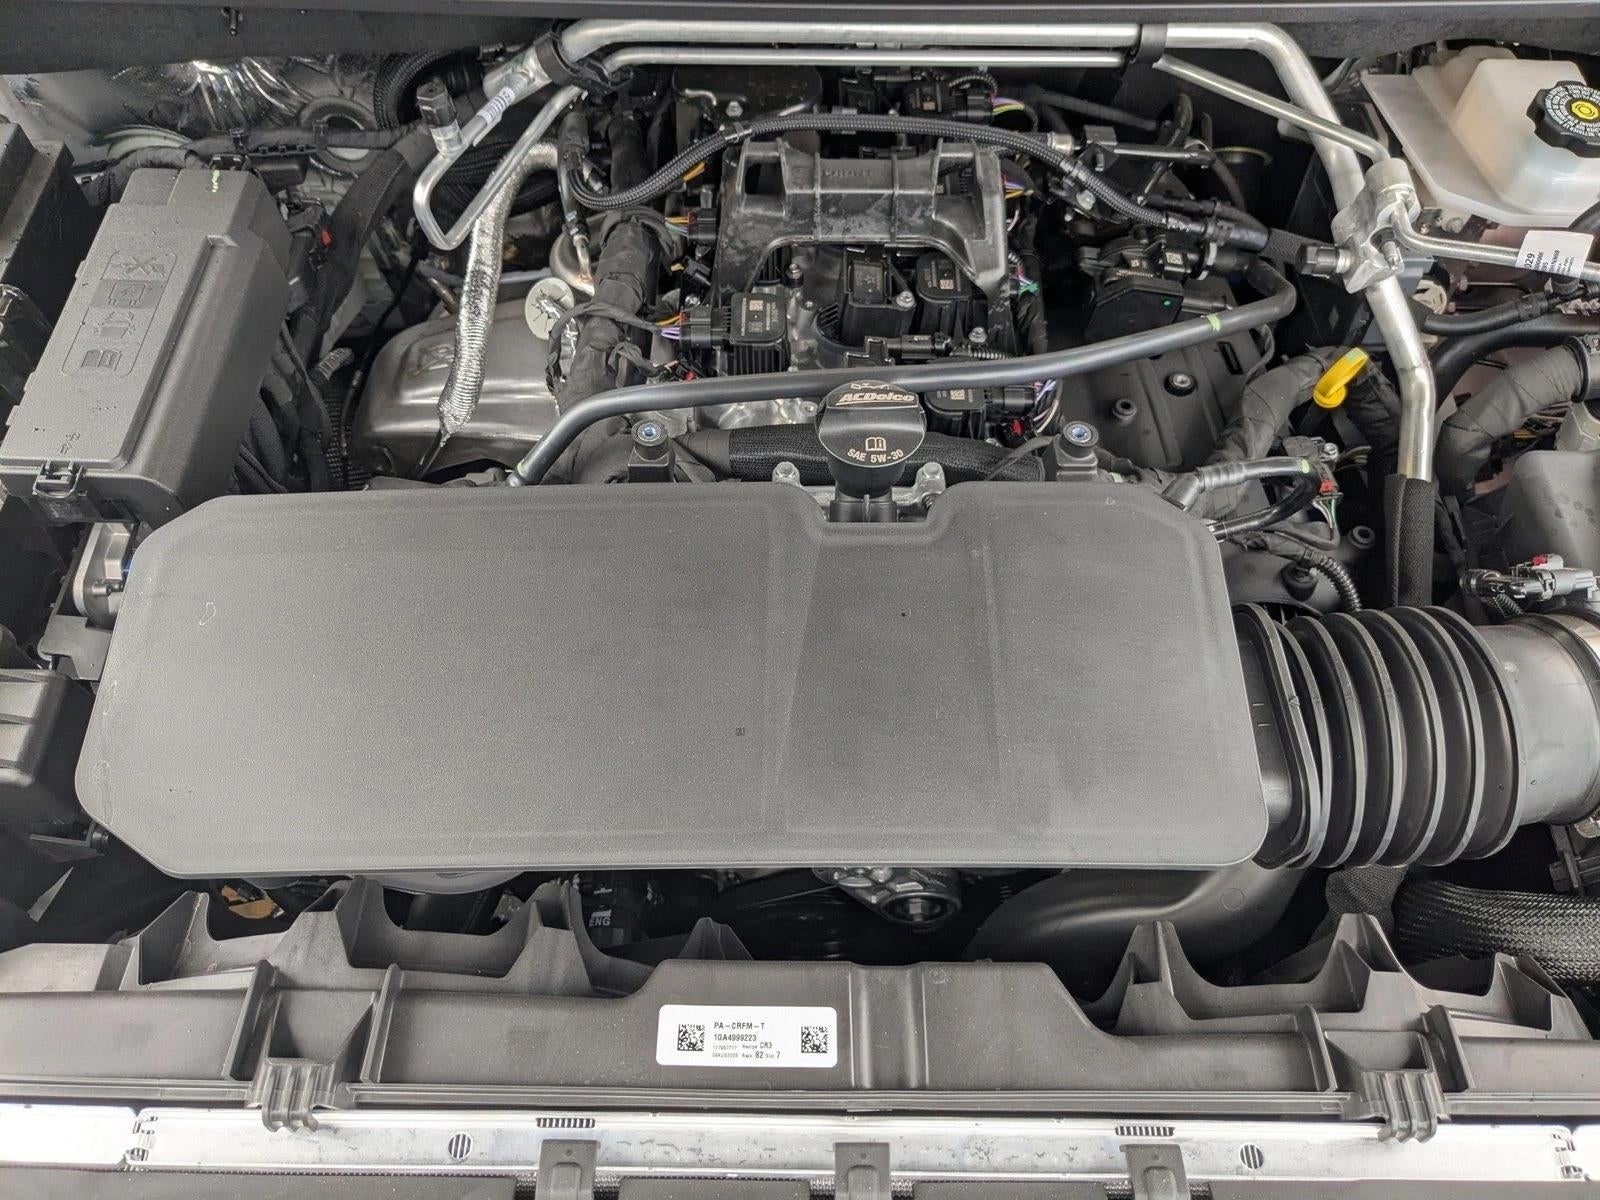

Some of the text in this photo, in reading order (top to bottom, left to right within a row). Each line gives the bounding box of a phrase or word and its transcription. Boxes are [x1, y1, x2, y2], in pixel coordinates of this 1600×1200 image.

[838, 392, 915, 402] ACDelco
[847, 448, 903, 462] SAE 5W-30
[755, 1050, 764, 1059] 82
[776, 1051, 780, 1059] 7
